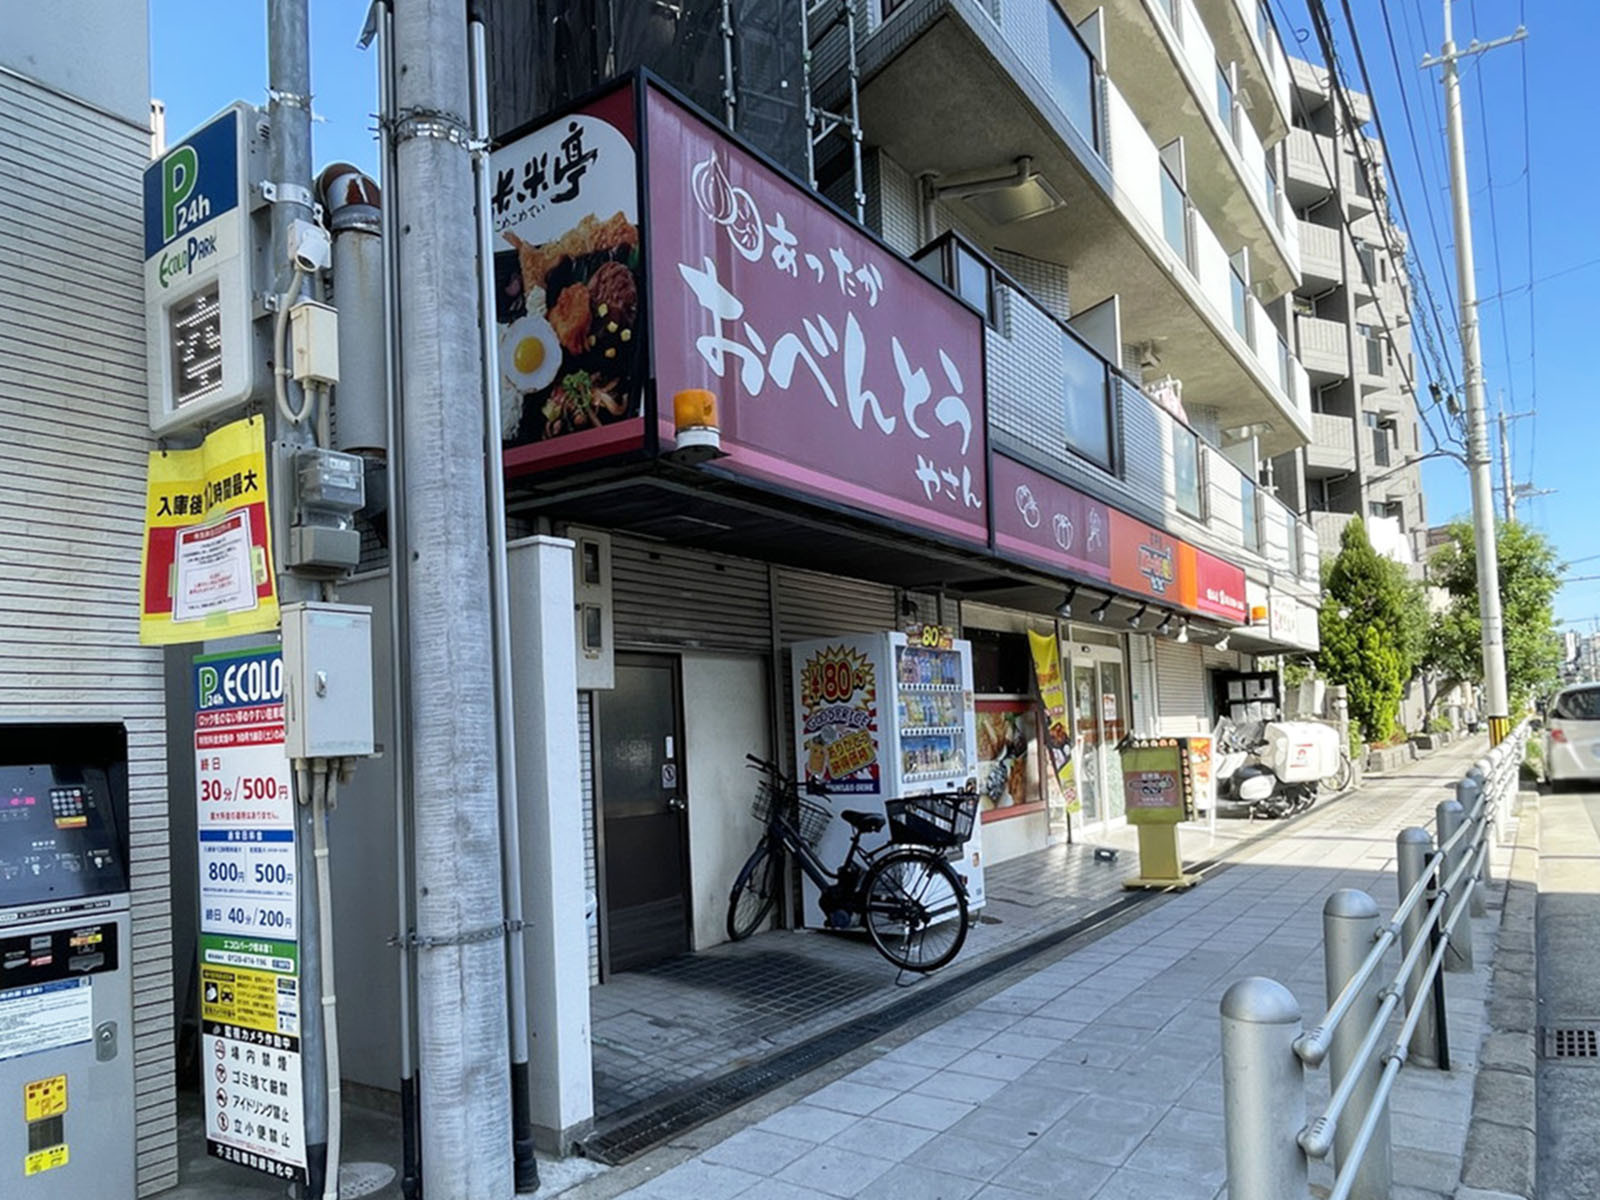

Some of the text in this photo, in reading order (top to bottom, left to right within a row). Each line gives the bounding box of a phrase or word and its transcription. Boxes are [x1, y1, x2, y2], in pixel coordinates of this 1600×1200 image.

[163, 145, 198, 244] P
[178, 195, 210, 232] 24h
[678, 256, 973, 456] おべんとう
[915, 453, 983, 510] やさん
[921, 625, 939, 647] 80
[224, 658, 284, 704] ECOLO
[208, 862, 245, 883] 800円
[255, 863, 294, 885] 500円
[231, 1045, 287, 1071] 場内禁煙
[232, 1070, 289, 1097] ゴミ捨て厳禁
[233, 1094, 289, 1123] アイドリング禁止
[234, 1118, 290, 1148] 立小便禁止
